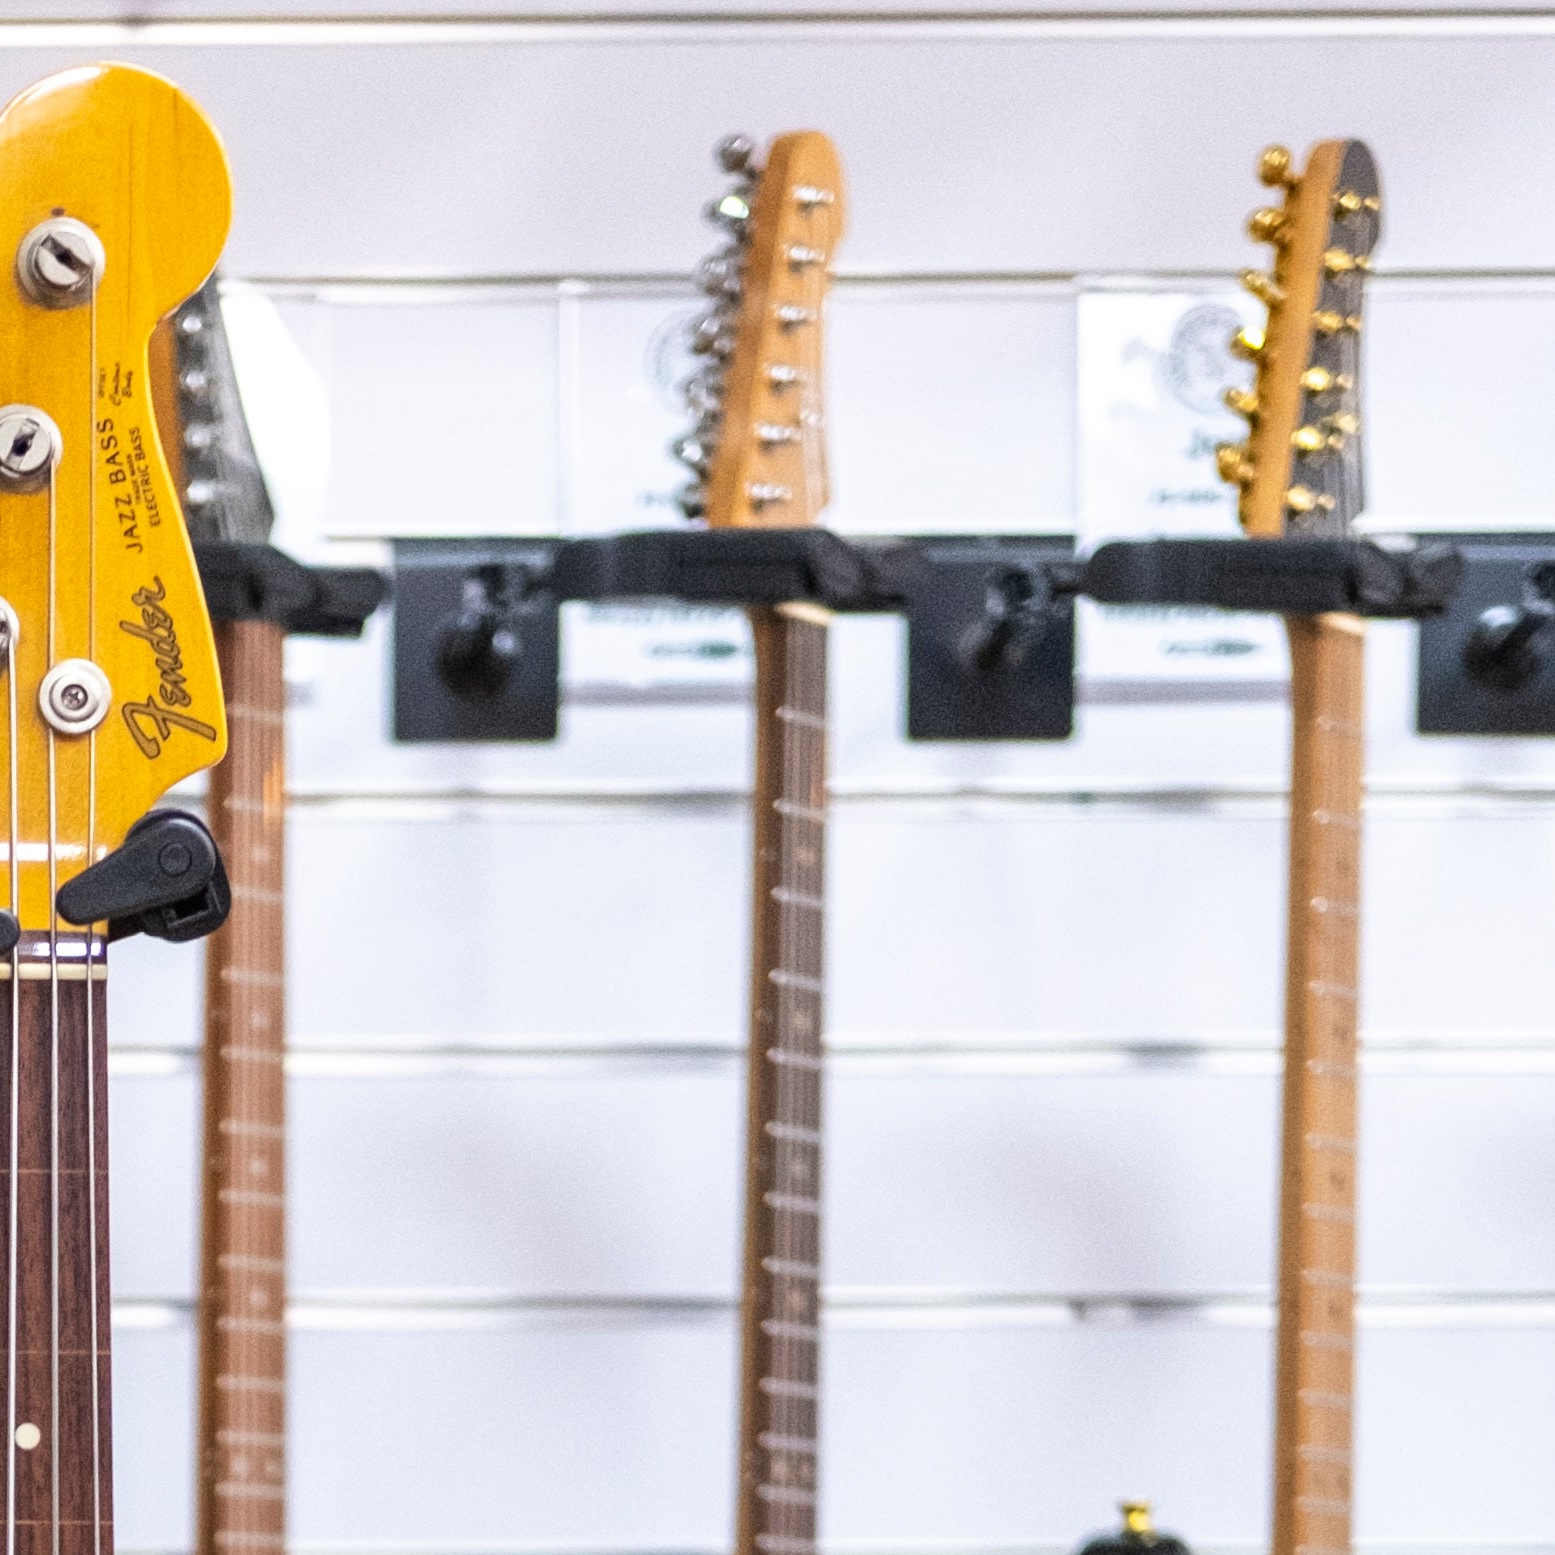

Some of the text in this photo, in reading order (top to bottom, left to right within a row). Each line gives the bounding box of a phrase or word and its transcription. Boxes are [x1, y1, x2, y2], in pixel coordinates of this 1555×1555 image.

[97, 418, 126, 484] BASS
[129, 427, 161, 528] ELECTRIC BASS
[115, 494, 143, 554] JAZZ
[119, 575, 217, 760] Fender
